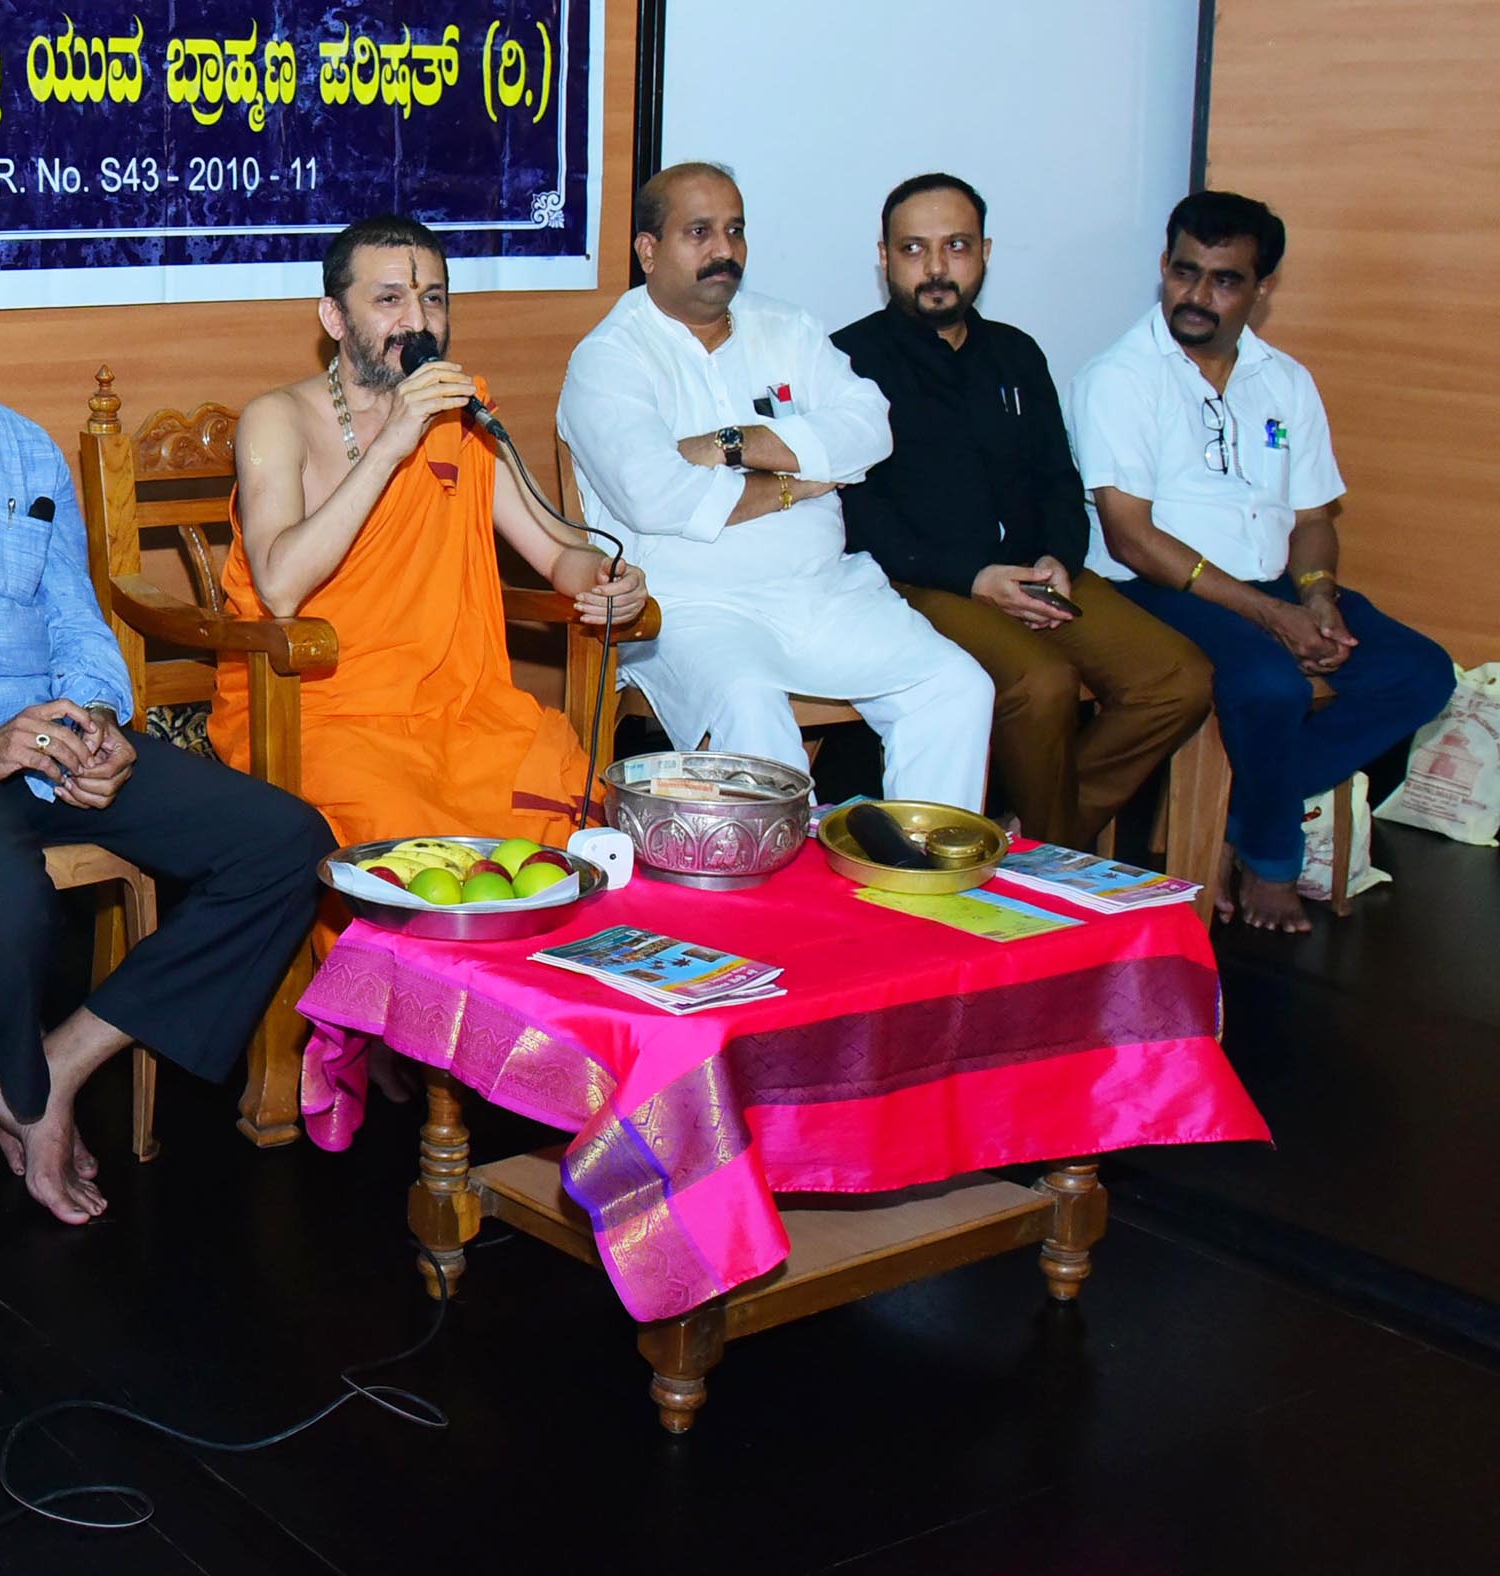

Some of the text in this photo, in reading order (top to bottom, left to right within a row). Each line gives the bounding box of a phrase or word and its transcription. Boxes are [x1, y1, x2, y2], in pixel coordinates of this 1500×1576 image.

[26, 12, 144, 103] ಯುವ
[167, 17, 297, 133] ಬ್ರಾಹ್ಮಣ
[319, 20, 460, 119] ಪರಿಷತ್
[482, 20, 552, 124] (ರಿ.)
[36, 156, 90, 194] No.
[100, 156, 160, 193] S43
[188, 156, 260, 192] 2010
[290, 155, 317, 190] 11
